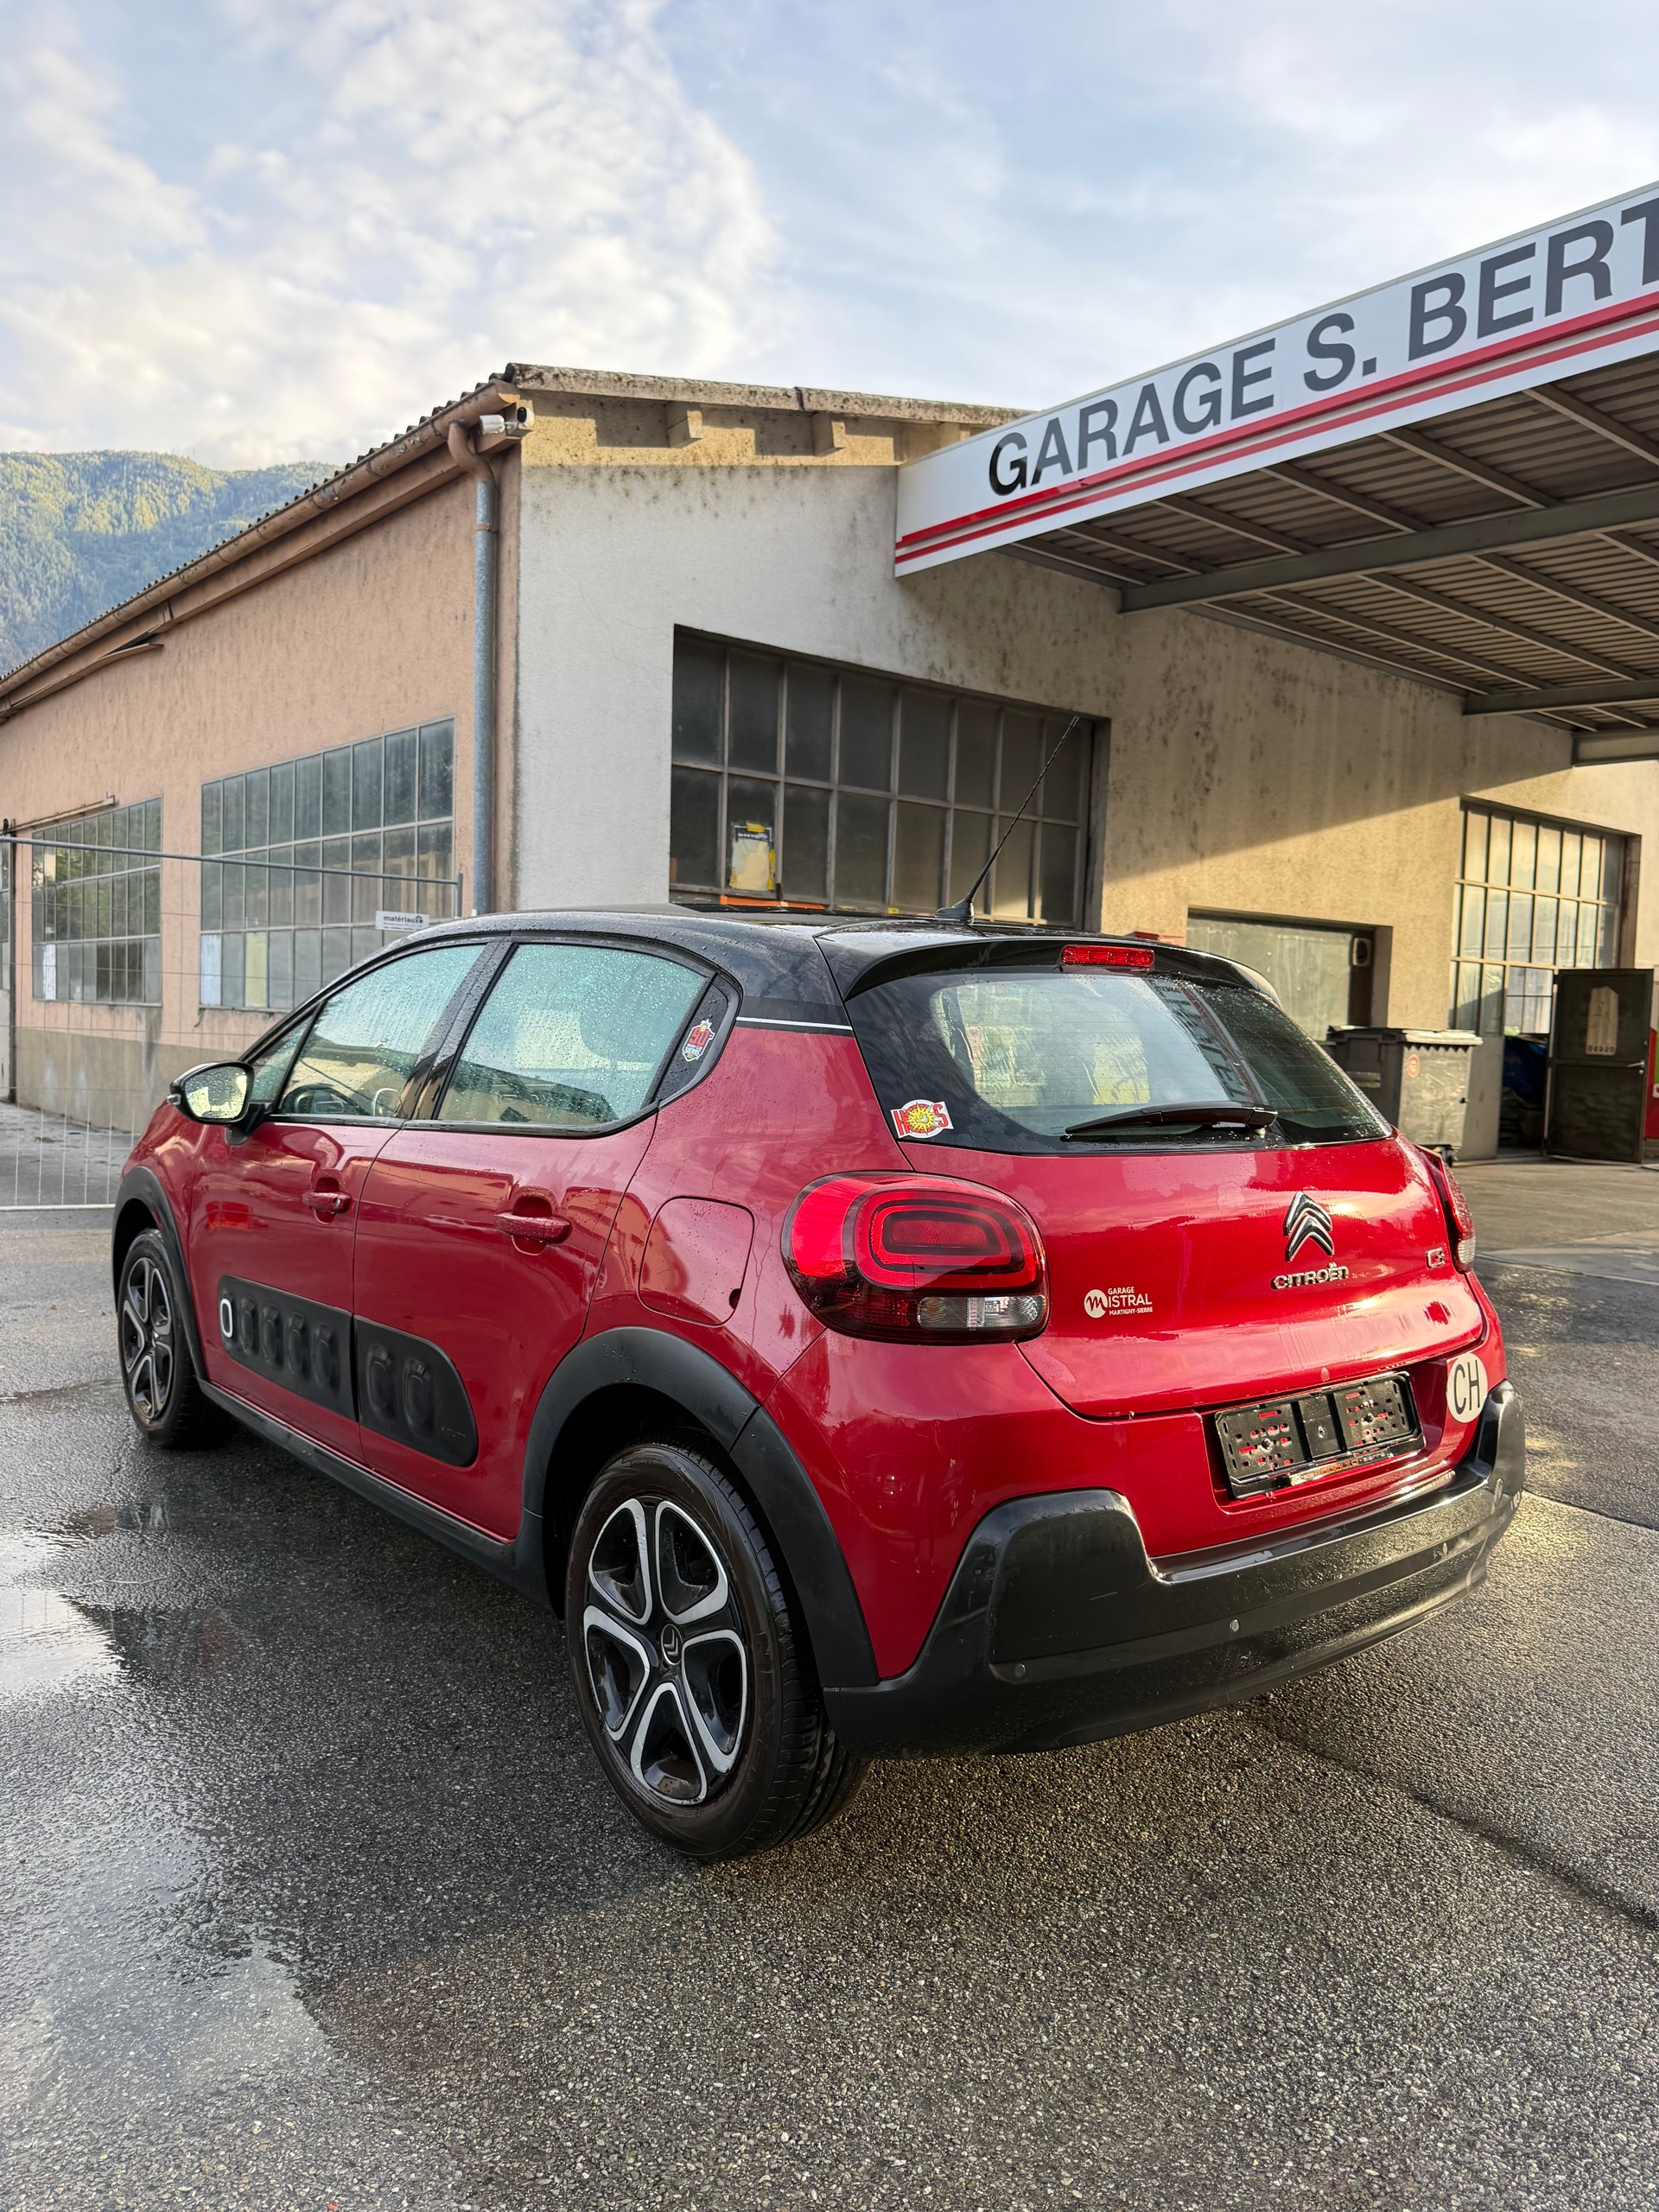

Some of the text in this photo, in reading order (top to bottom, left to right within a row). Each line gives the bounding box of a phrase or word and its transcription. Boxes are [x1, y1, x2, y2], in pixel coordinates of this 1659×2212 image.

[988, 197, 1659, 496] GARAGE S. BERT
[1108, 1287, 1135, 1295] GARAGE
[1109, 1306, 1154, 1316] MARTIGNY-SIERRE
[1453, 1359, 1480, 1415] CH
